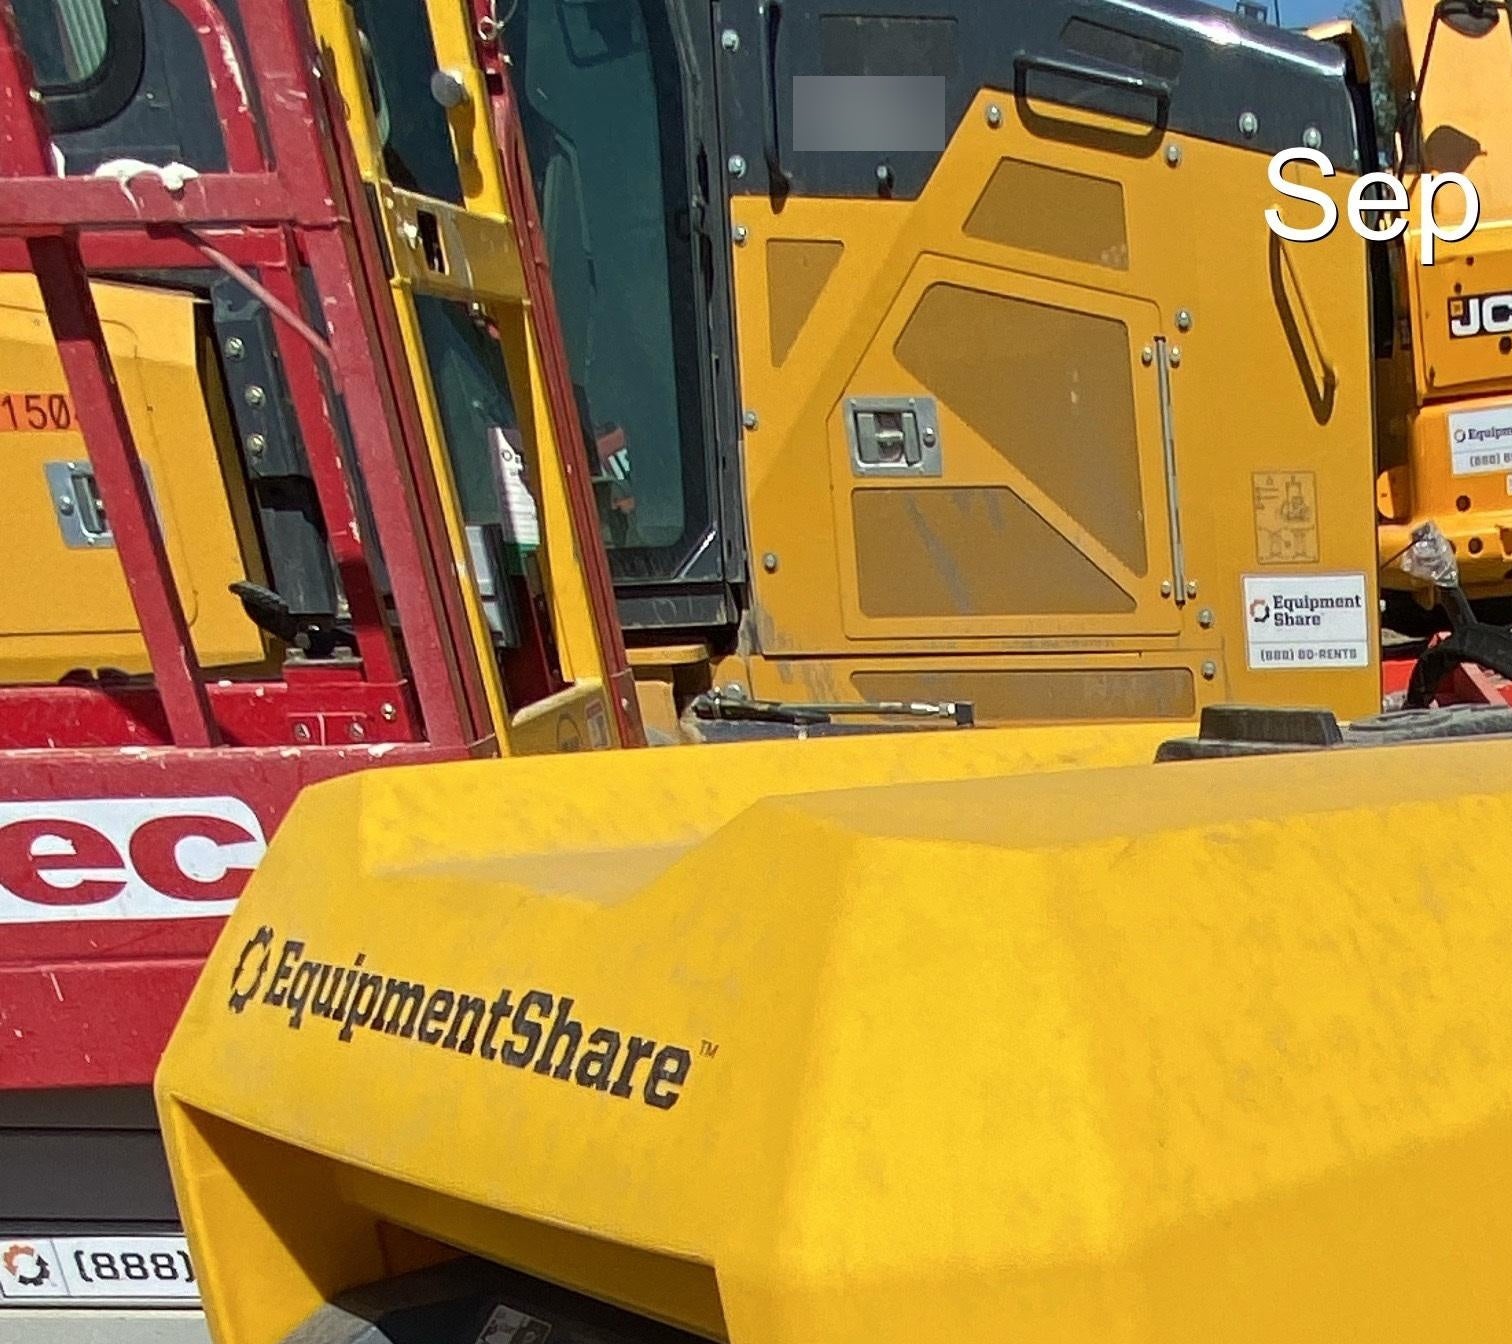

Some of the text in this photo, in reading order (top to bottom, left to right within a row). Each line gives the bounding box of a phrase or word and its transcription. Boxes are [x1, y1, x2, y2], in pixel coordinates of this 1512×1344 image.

[1273, 595, 1362, 611] Equipment
[1274, 612, 1321, 627] Share
[74, 1250, 196, 1283] (888)
